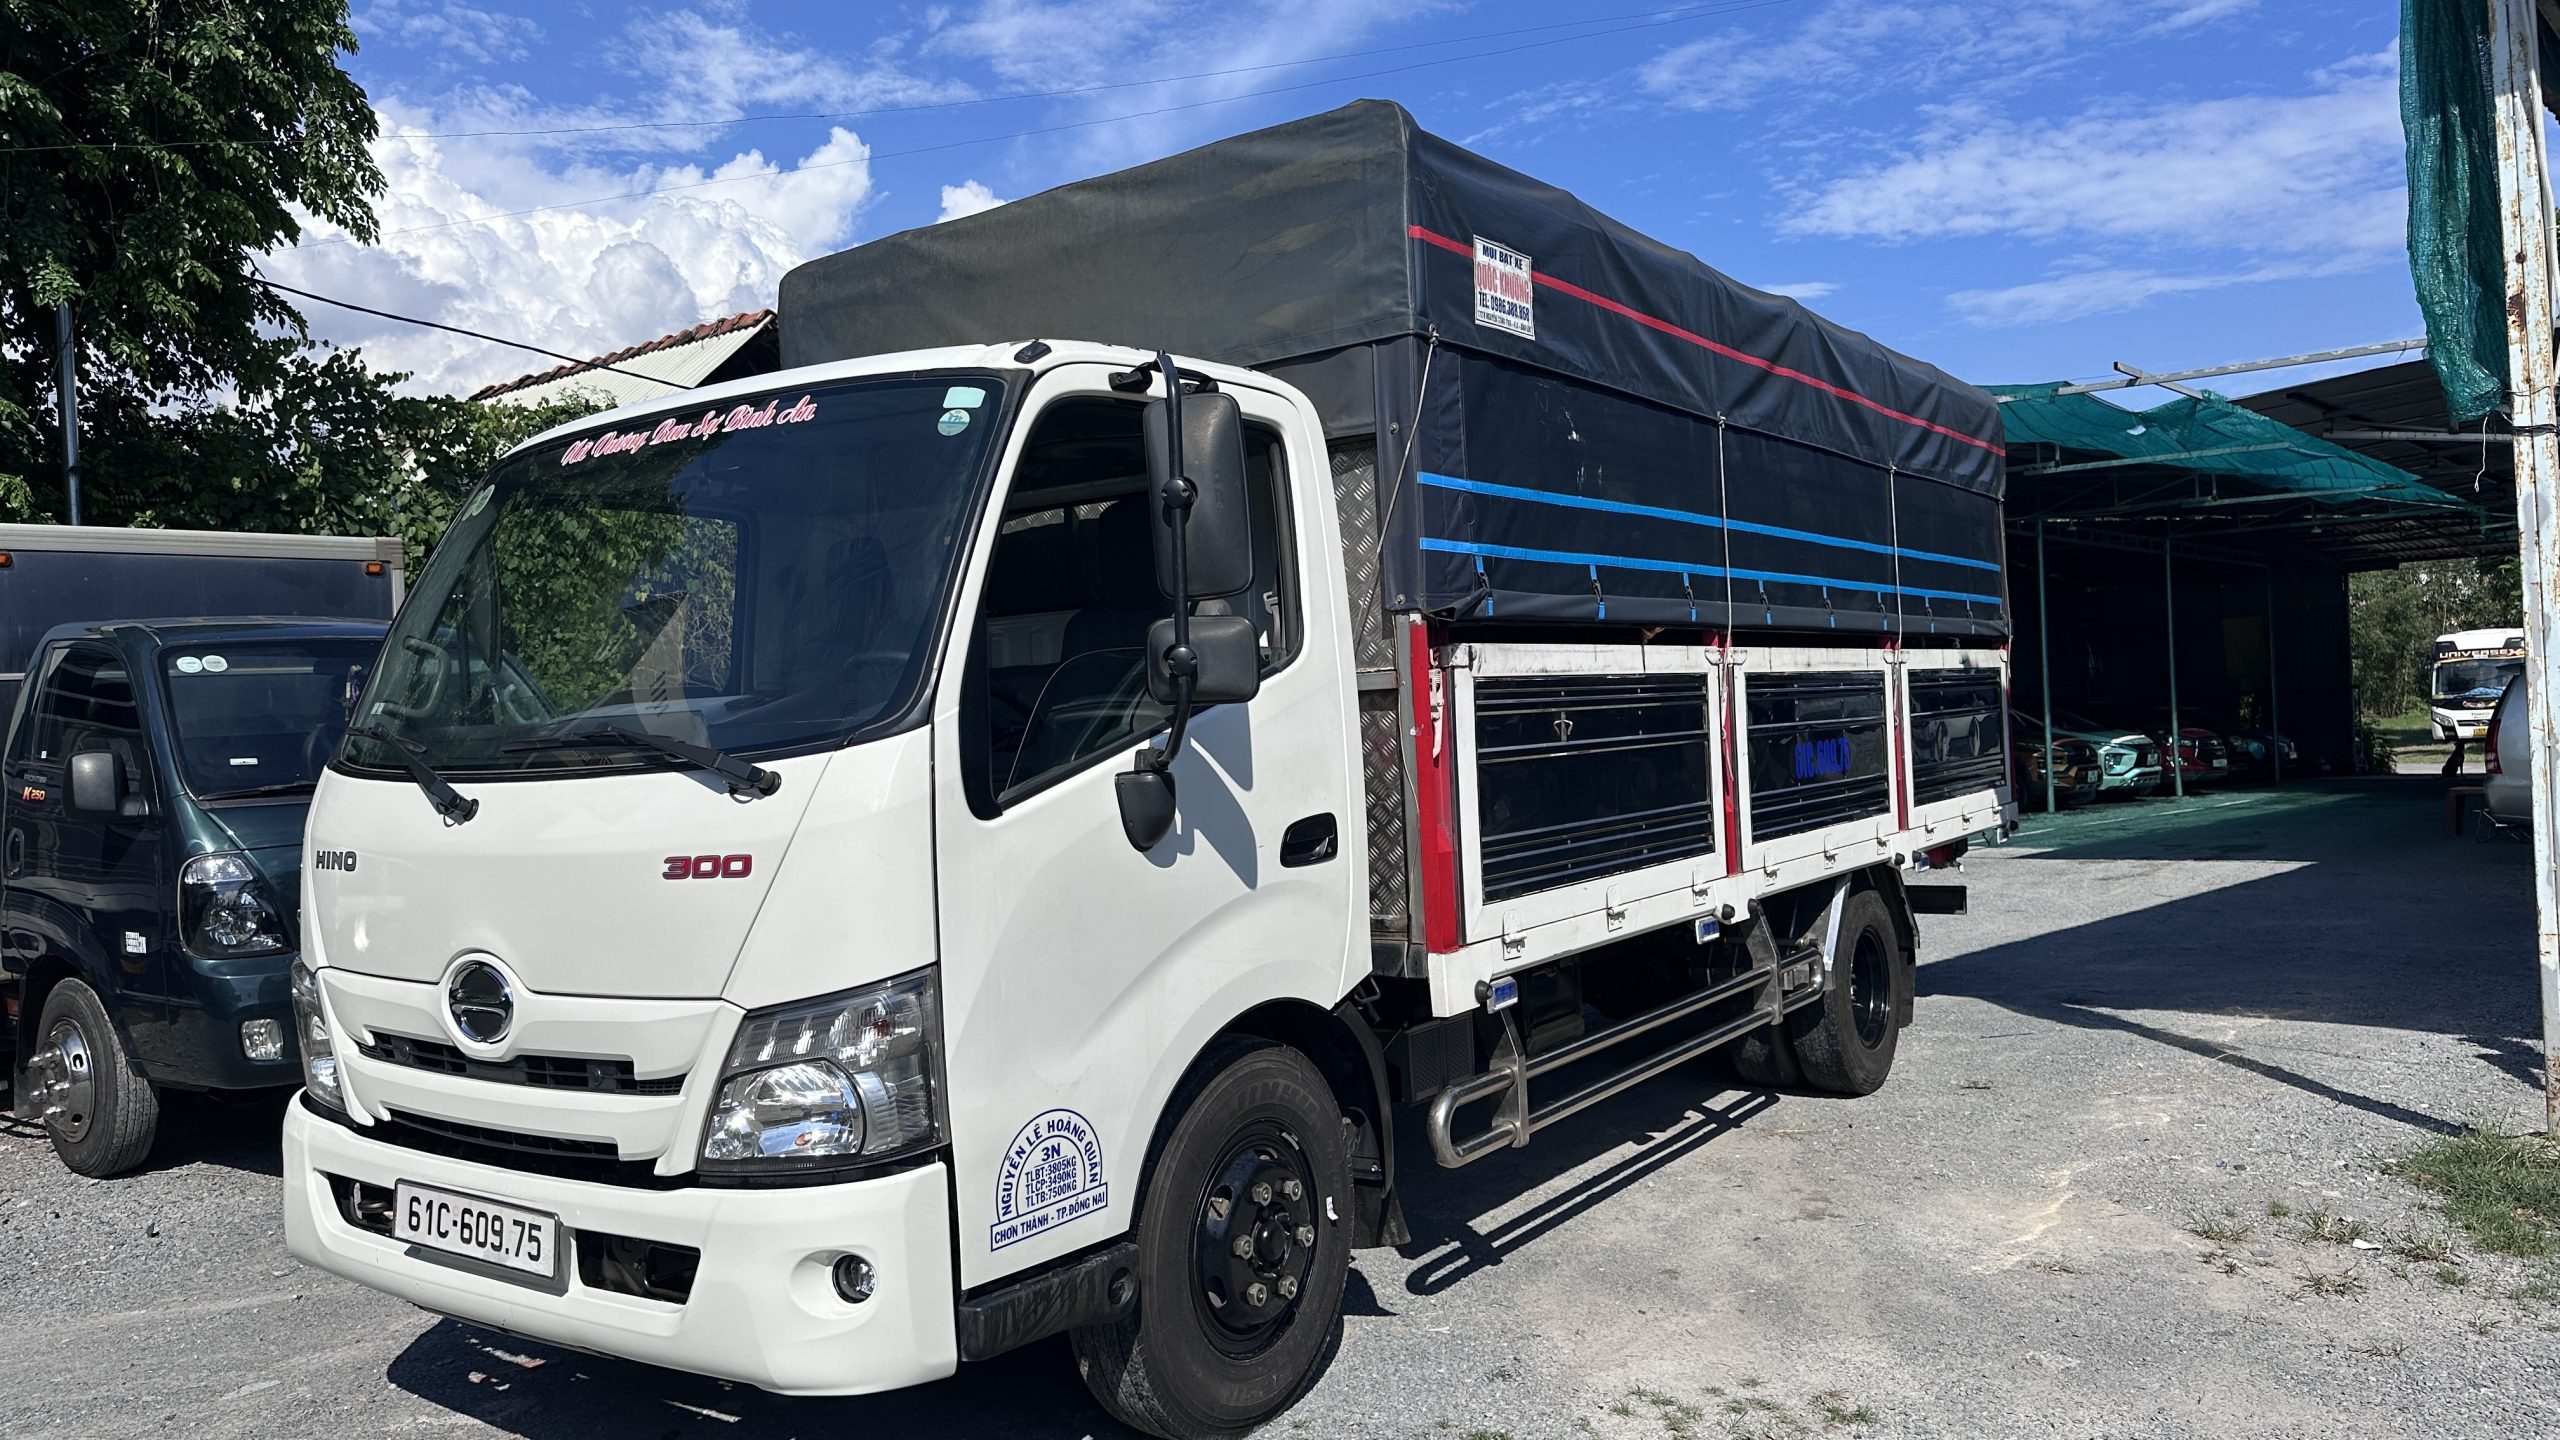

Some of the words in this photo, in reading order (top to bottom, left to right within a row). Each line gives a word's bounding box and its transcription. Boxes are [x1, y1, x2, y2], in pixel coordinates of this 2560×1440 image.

[1477, 259, 1498, 292] QUỐC
[1515, 257, 1523, 270] XE
[649, 418, 692, 445] Ban
[691, 410, 725, 440] Sự
[722, 399, 779, 432] Bình
[777, 395, 817, 424] An
[315, 850, 357, 872] HINO
[662, 854, 753, 880] 300
[1001, 1145, 1027, 1217] NGUYỄN
[1026, 1123, 1043, 1147] LÊ
[1047, 1116, 1087, 1142] HOÀNG
[1084, 1140, 1102, 1184] QUÂN
[1041, 1143, 1061, 1162] 3N
[1025, 1155, 1077, 1183] TLBT:3805KG
[1025, 1167, 1077, 1196] TLCP:3490KG
[1025, 1180, 1077, 1208] TLTB:7500KG
[408, 1196, 542, 1262] 61C-609.75
[994, 1225, 1018, 1244] CHƠN
[1020, 1213, 1049, 1235] THÀNH
[1092, 1191, 1105, 1207] NAI
